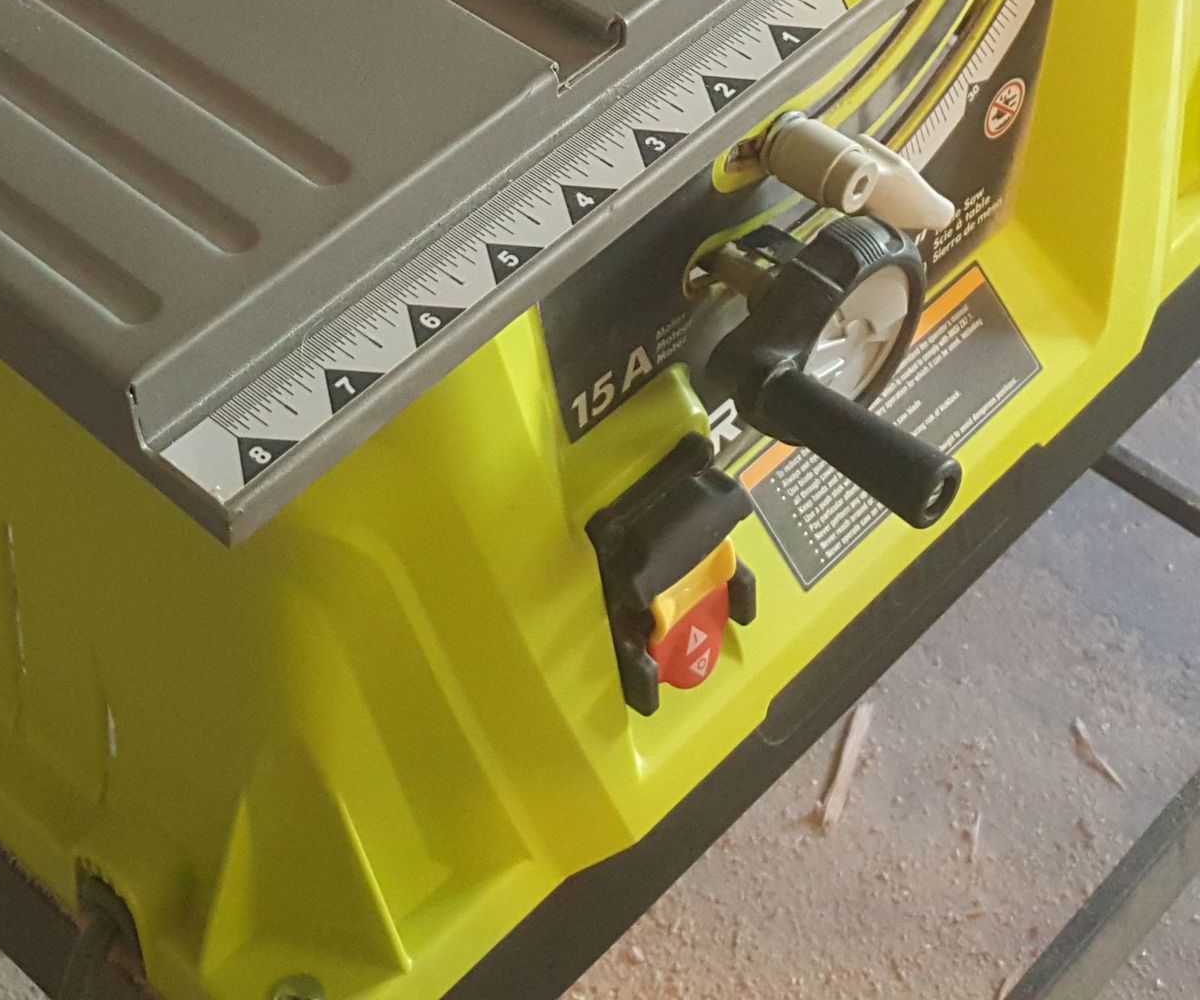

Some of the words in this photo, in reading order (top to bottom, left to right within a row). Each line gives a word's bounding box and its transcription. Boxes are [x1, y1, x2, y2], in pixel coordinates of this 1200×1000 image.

[963, 187, 985, 212] Saw
[965, 196, 992, 221] table
[249, 446, 272, 465] 8
[334, 376, 356, 395] 7
[419, 312, 442, 330] 6
[497, 251, 520, 268] 5
[576, 191, 596, 208] 4
[645, 136, 666, 152] 3
[713, 82, 736, 99] 2
[781, 31, 801, 44] 1
[570, 370, 616, 429] 15
[622, 344, 653, 388] A
